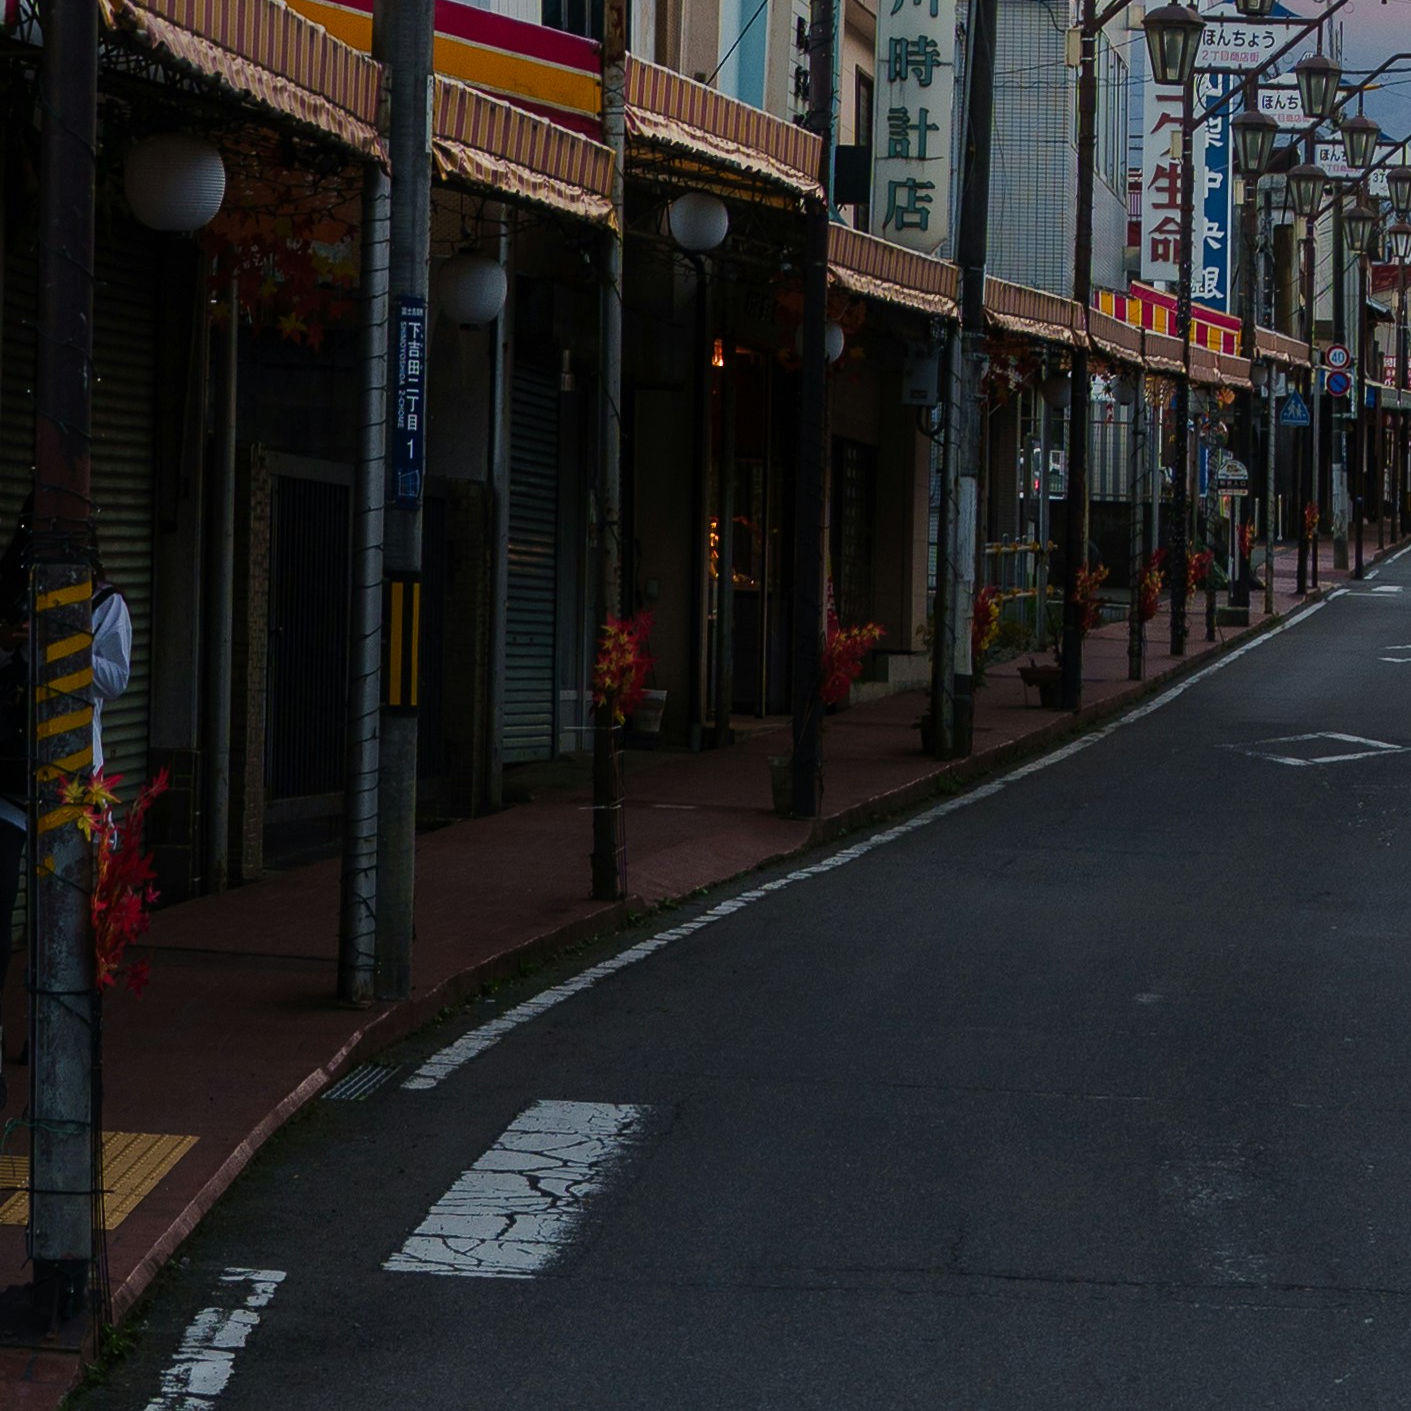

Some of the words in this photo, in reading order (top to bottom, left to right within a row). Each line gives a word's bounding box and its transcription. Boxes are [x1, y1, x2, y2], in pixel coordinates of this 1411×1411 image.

[1202, 29, 1276, 49] ほんちょう
[1201, 49, 1260, 63] 2丁目商店街
[1262, 94, 1299, 110] ほんち
[1329, 350, 1347, 365] 40
[406, 321, 422, 432] 下吉田二丁目
